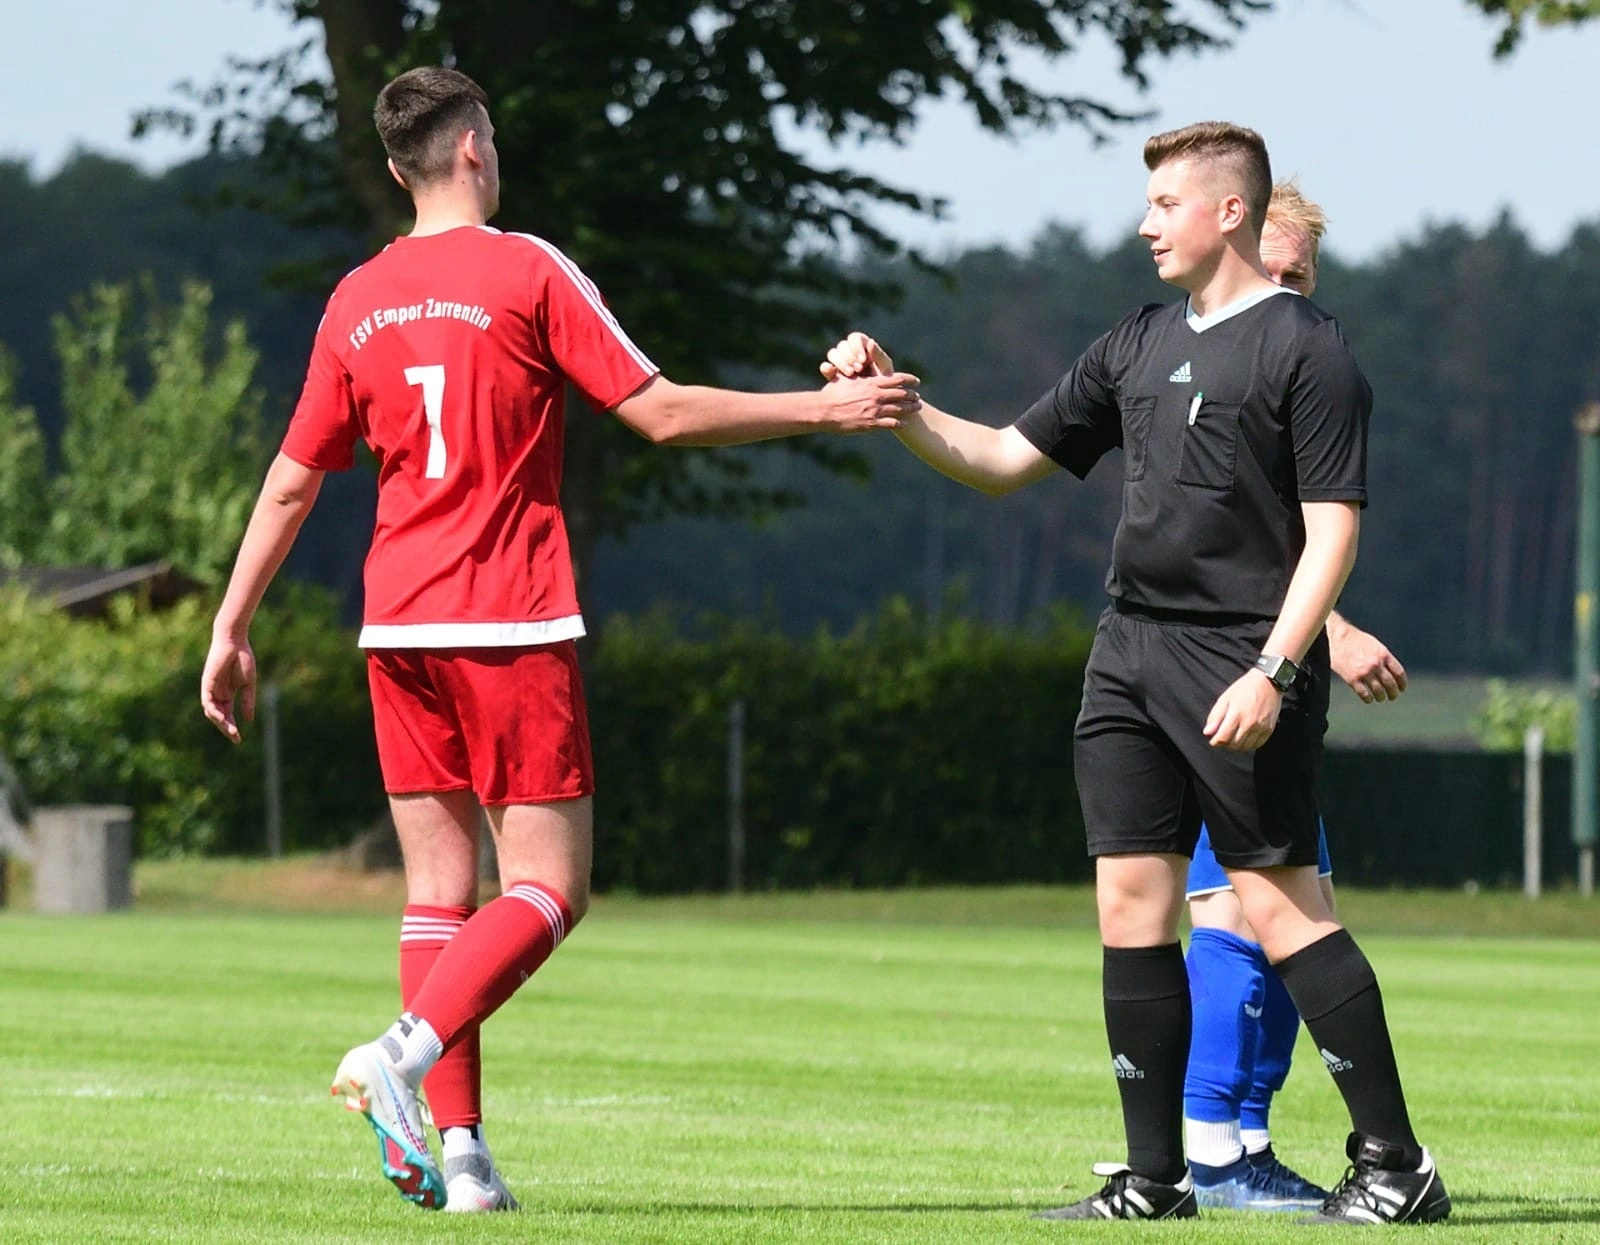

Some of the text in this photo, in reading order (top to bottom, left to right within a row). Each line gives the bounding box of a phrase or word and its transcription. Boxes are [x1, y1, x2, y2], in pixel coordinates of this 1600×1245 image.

[373, 304, 424, 330] Empor
[425, 298, 492, 331] Zarrentin
[403, 364, 447, 479] 7
